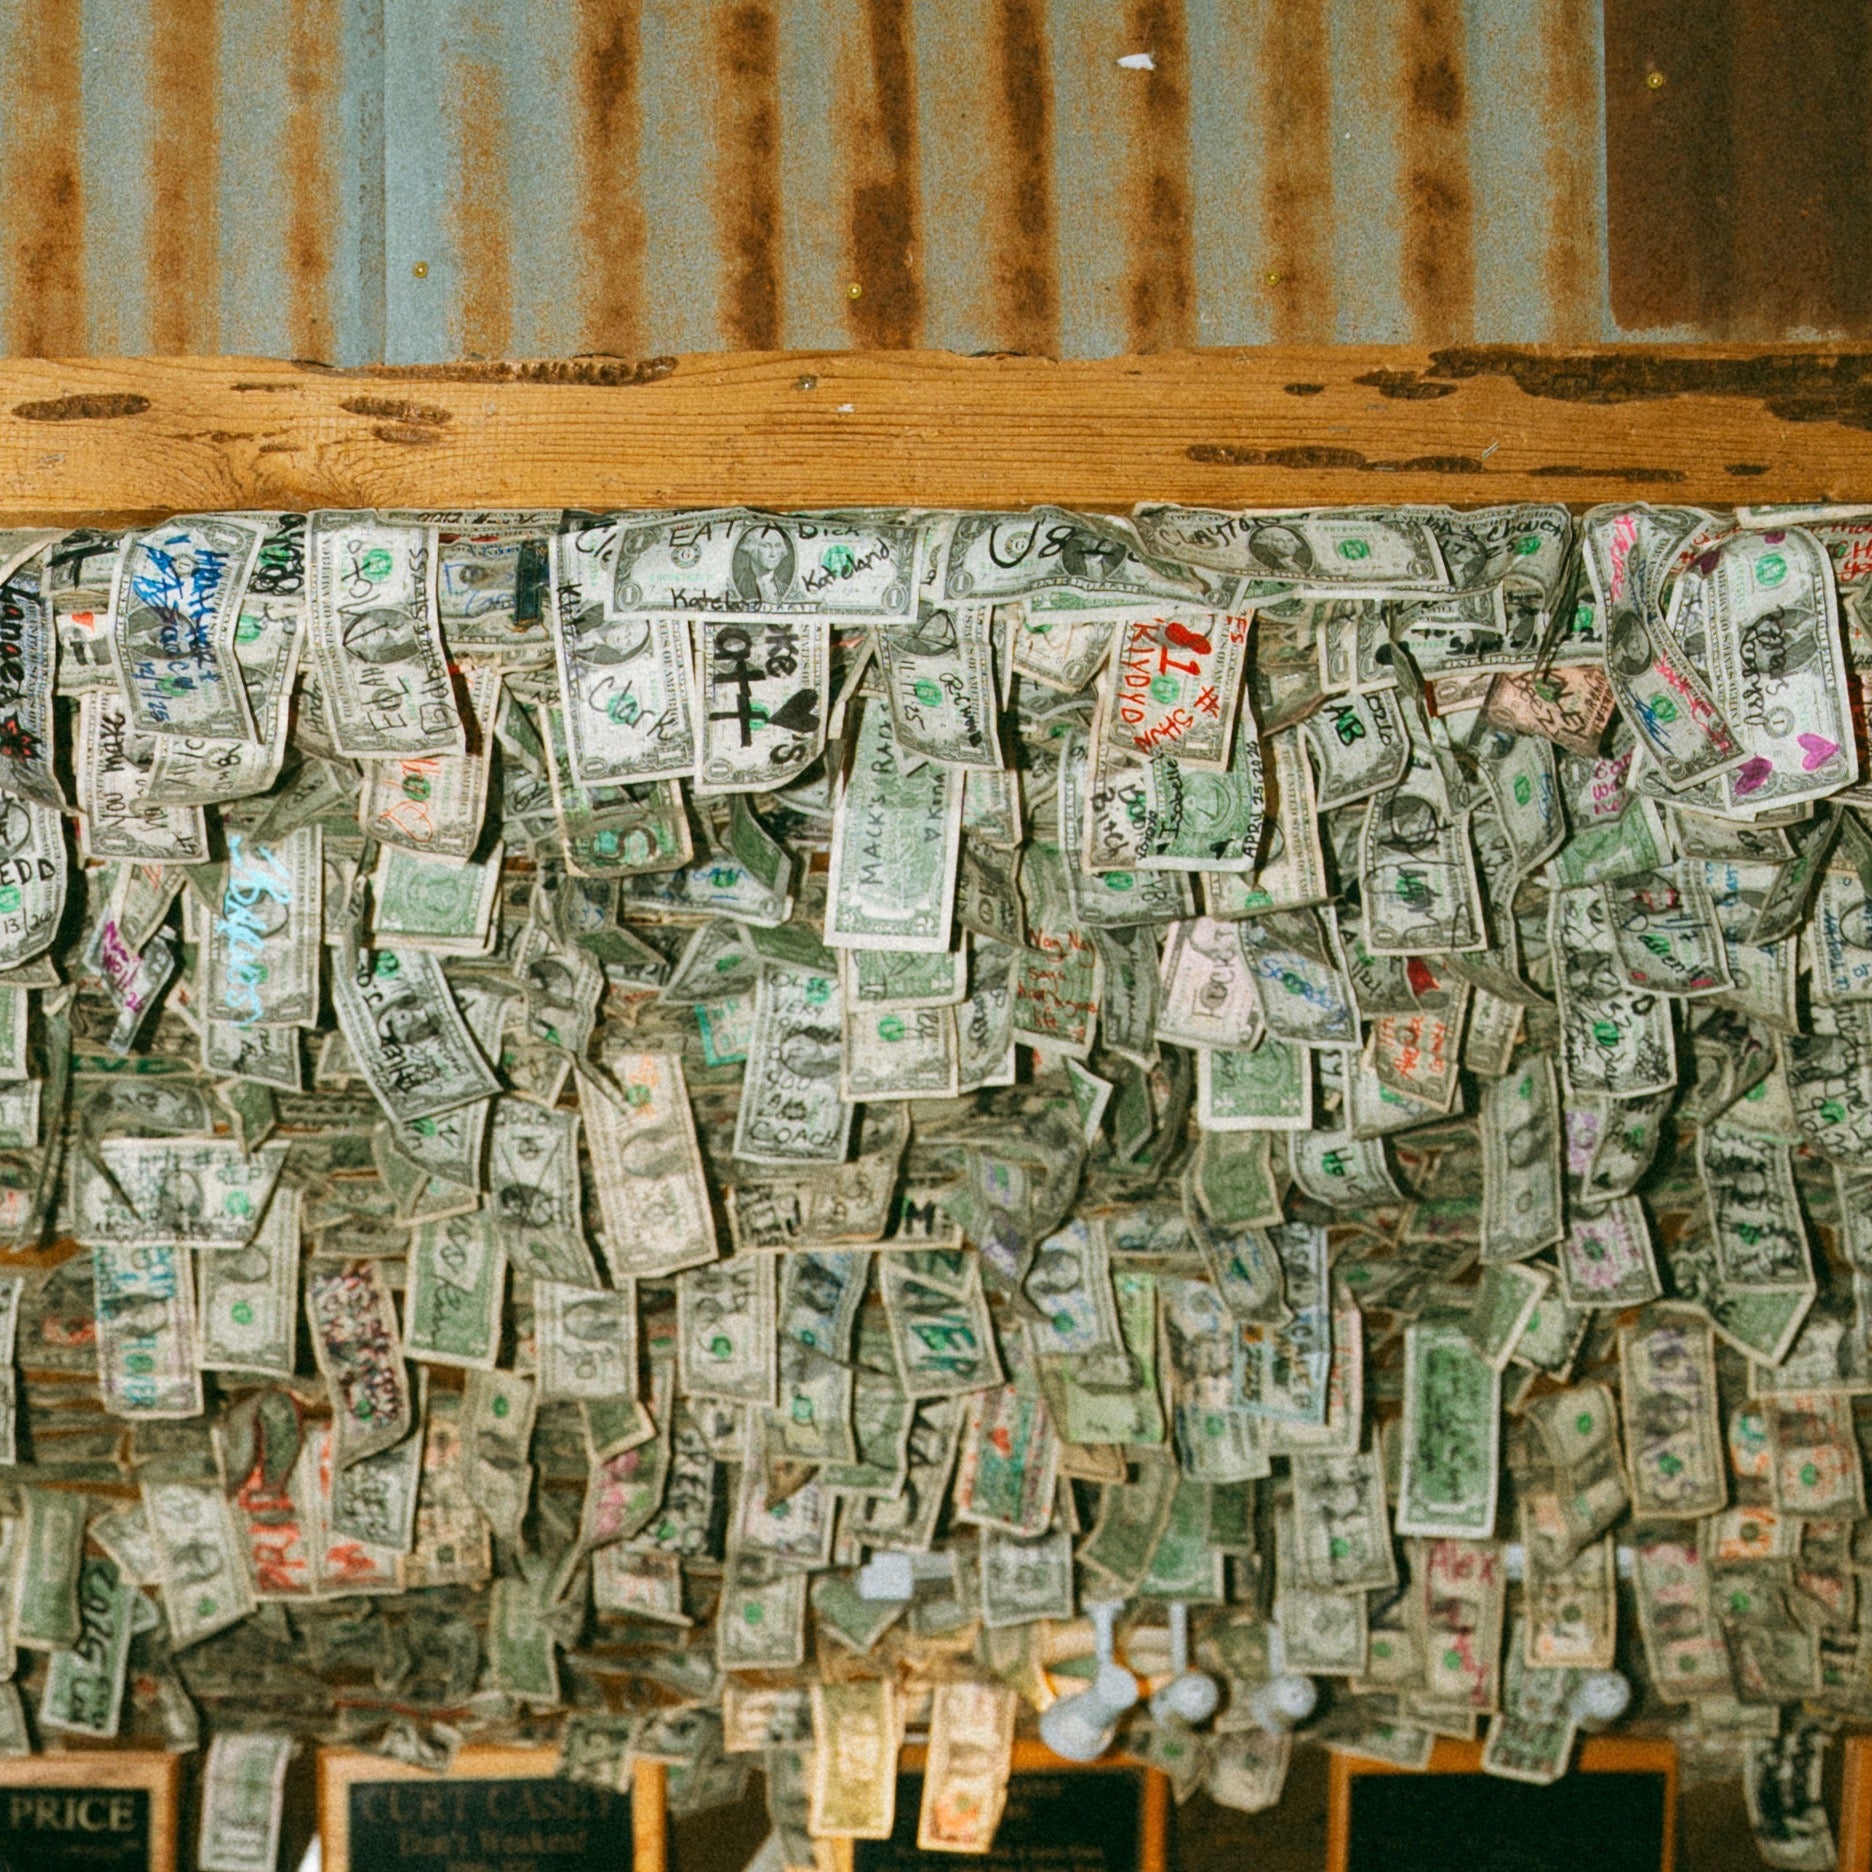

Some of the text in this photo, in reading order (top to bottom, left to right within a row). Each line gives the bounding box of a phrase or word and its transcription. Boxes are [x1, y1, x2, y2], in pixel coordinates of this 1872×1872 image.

[669, 520, 737, 547] EAT
[588, 674, 676, 744] Clark
[7, 1794, 138, 1833] PRICE
